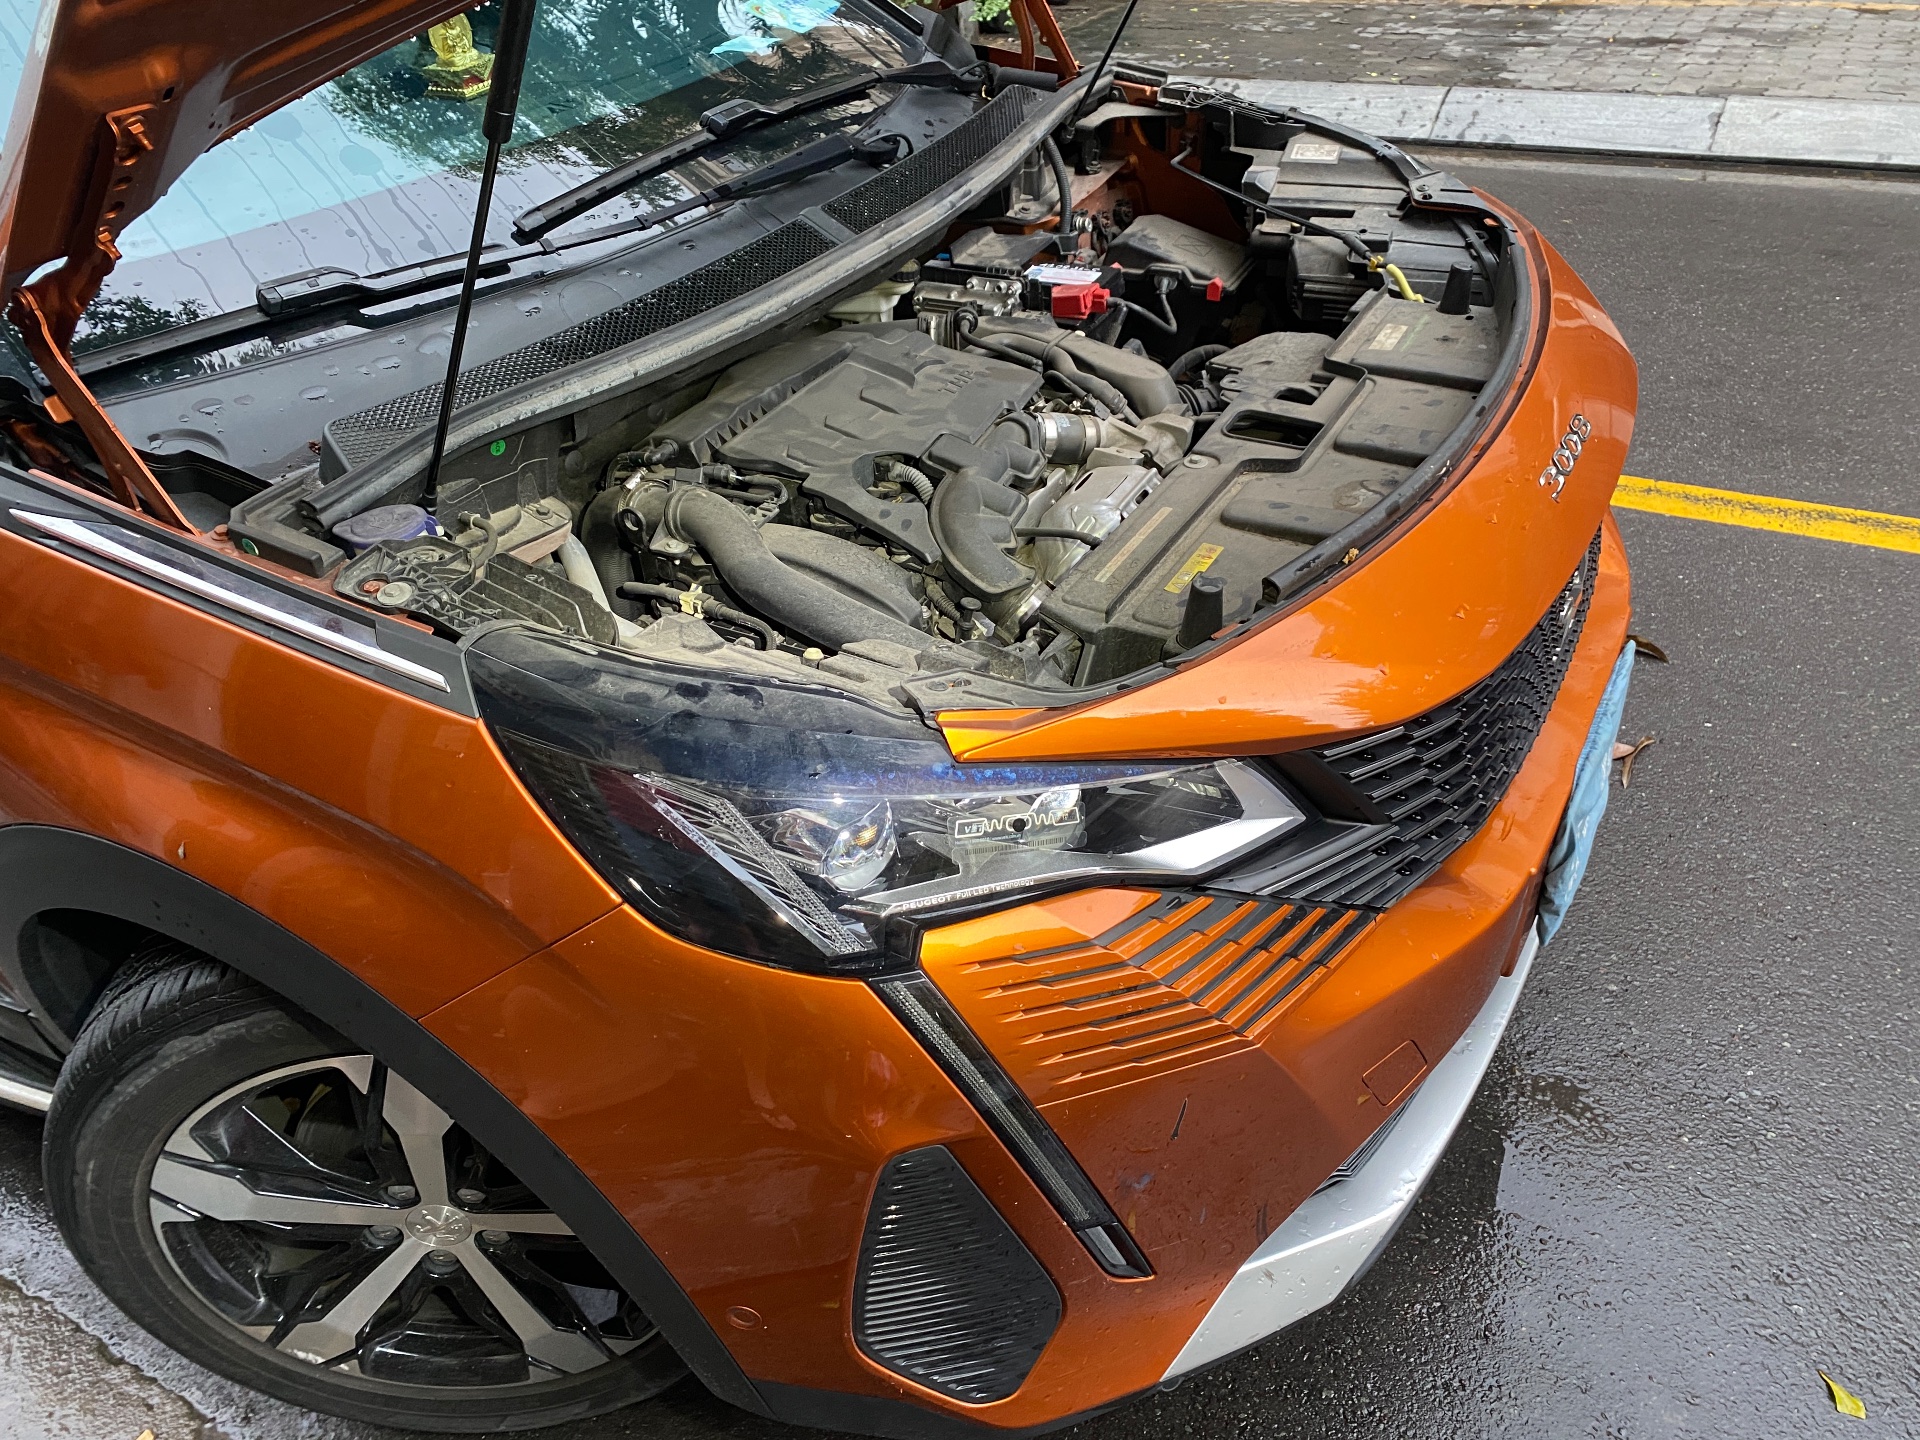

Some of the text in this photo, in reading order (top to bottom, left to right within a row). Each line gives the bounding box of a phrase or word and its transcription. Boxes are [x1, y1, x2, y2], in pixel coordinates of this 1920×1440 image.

[1538, 414, 1591, 503] 3008
[903, 894, 952, 910] PEUGEOT
[973, 886, 990, 897] LED
[992, 879, 1034, 892] Technology
